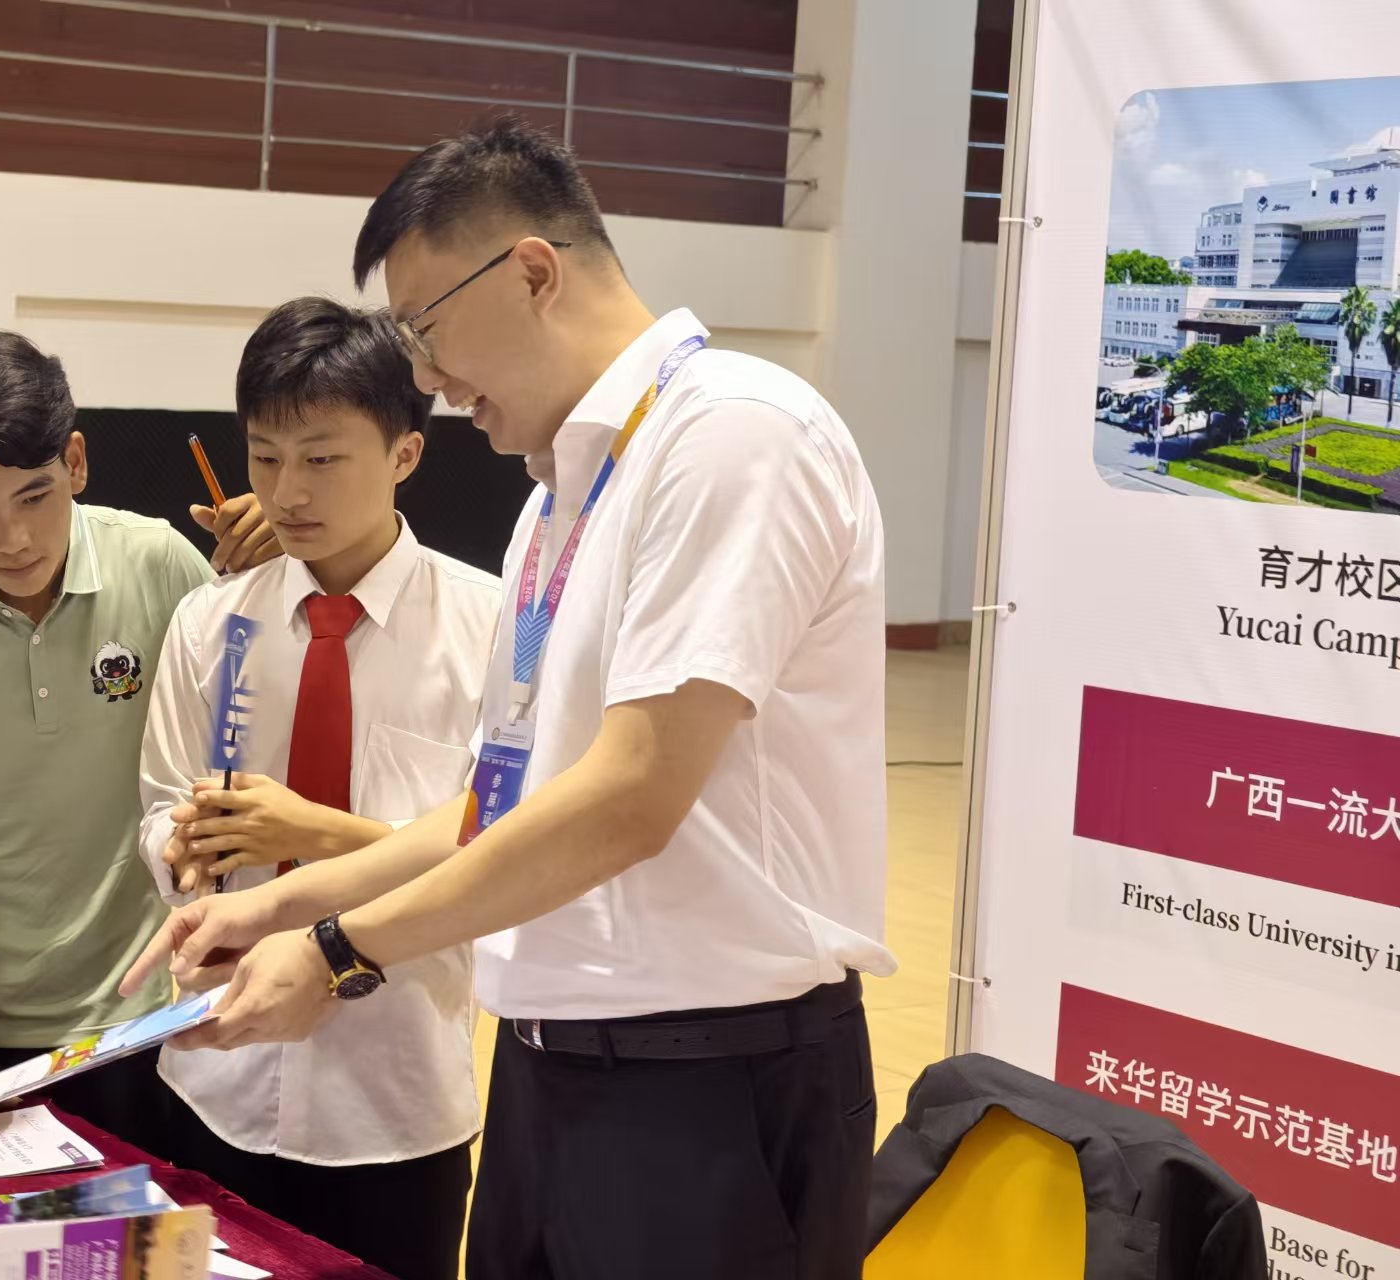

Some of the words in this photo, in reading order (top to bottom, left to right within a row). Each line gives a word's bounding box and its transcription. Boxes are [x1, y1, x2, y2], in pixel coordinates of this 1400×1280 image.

[548, 584, 562, 604] 2026
[1258, 545, 1400, 602] 育才校区
[1216, 605, 1303, 646] Yucai
[1206, 766, 1400, 842] 广西一流大
[1121, 882, 1240, 932] First-class
[1247, 912, 1380, 972] University
[1085, 1050, 1399, 1184] 来华留学示范基地
[1269, 1226, 1329, 1268] Base
[1334, 1248, 1376, 1280] for
